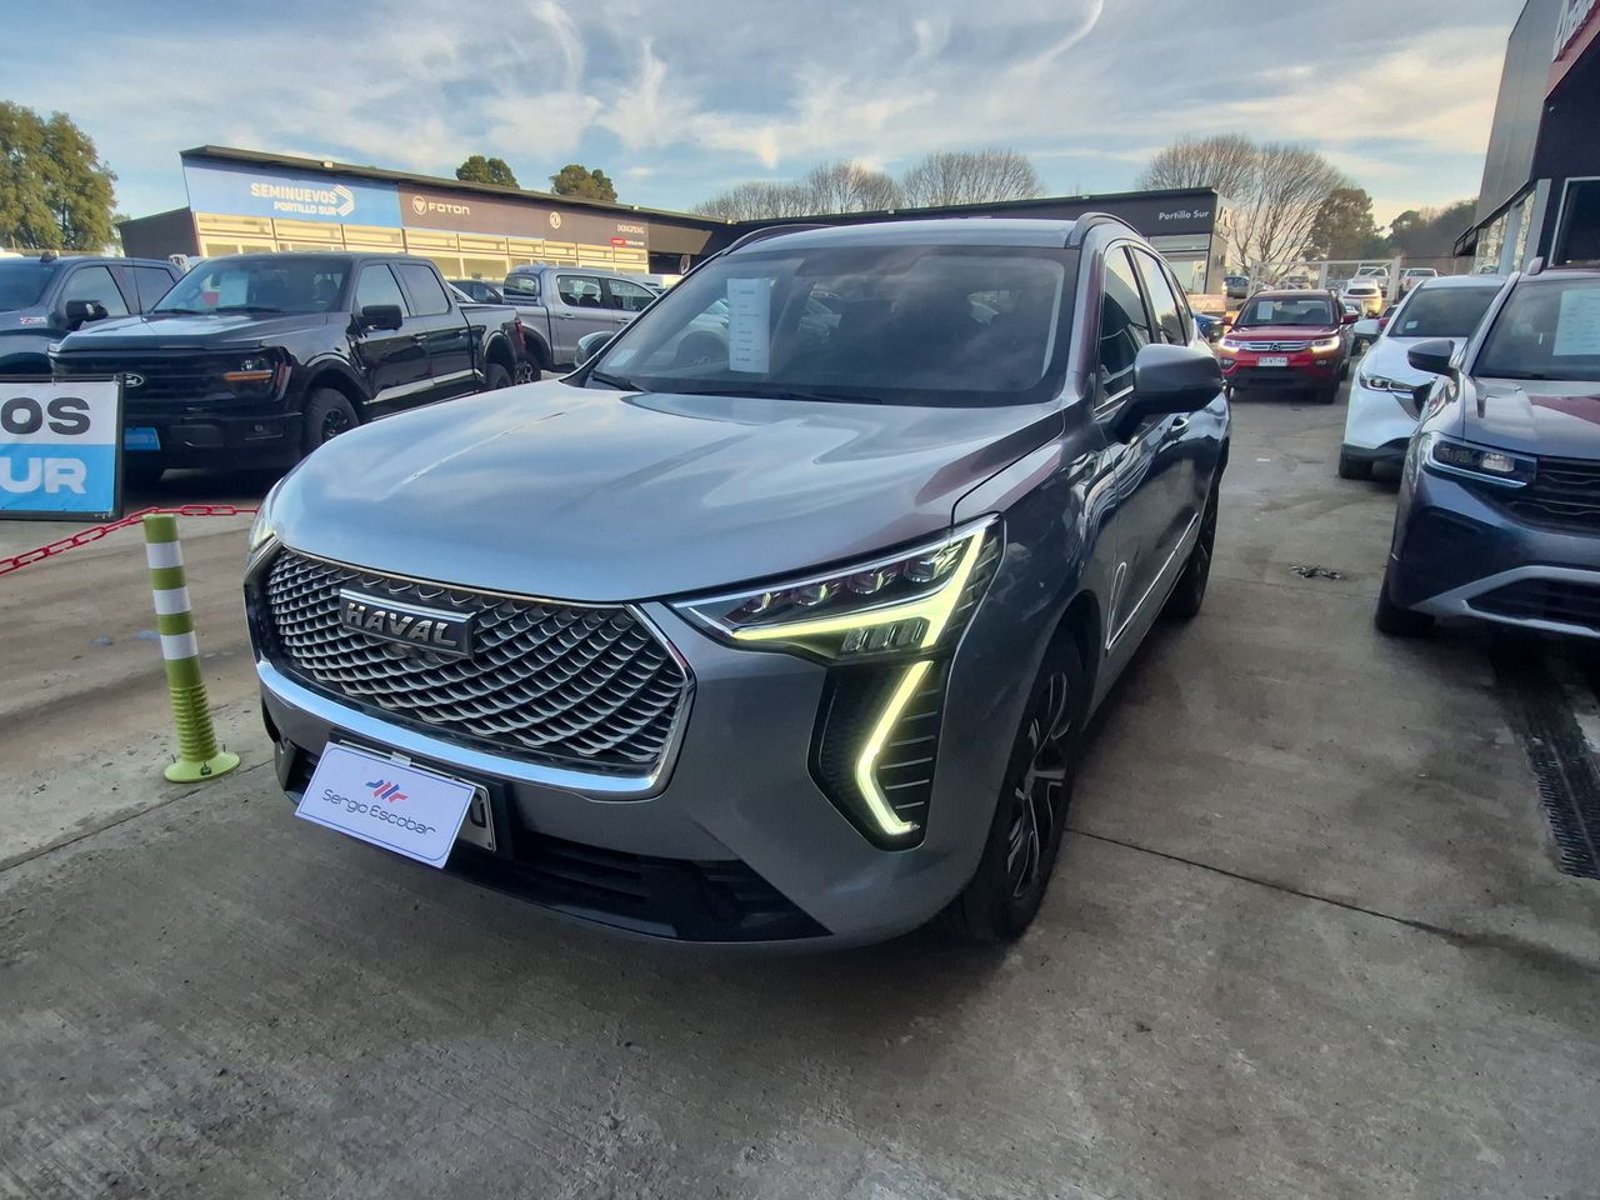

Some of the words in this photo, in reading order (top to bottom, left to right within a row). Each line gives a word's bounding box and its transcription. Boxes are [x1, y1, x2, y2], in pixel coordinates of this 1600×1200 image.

[250, 182, 338, 205] SEMINUEVOS
[273, 201, 317, 214] PORTILLO
[428, 202, 470, 216] FOTON
[1159, 210, 1191, 220] Portillo
[1193, 209, 1210, 218] Sur
[1, 397, 91, 435] OS
[0, 457, 87, 494] UR
[346, 602, 457, 647] HAVAL
[322, 788, 368, 814] Sergo
[369, 804, 436, 835] Escobar
